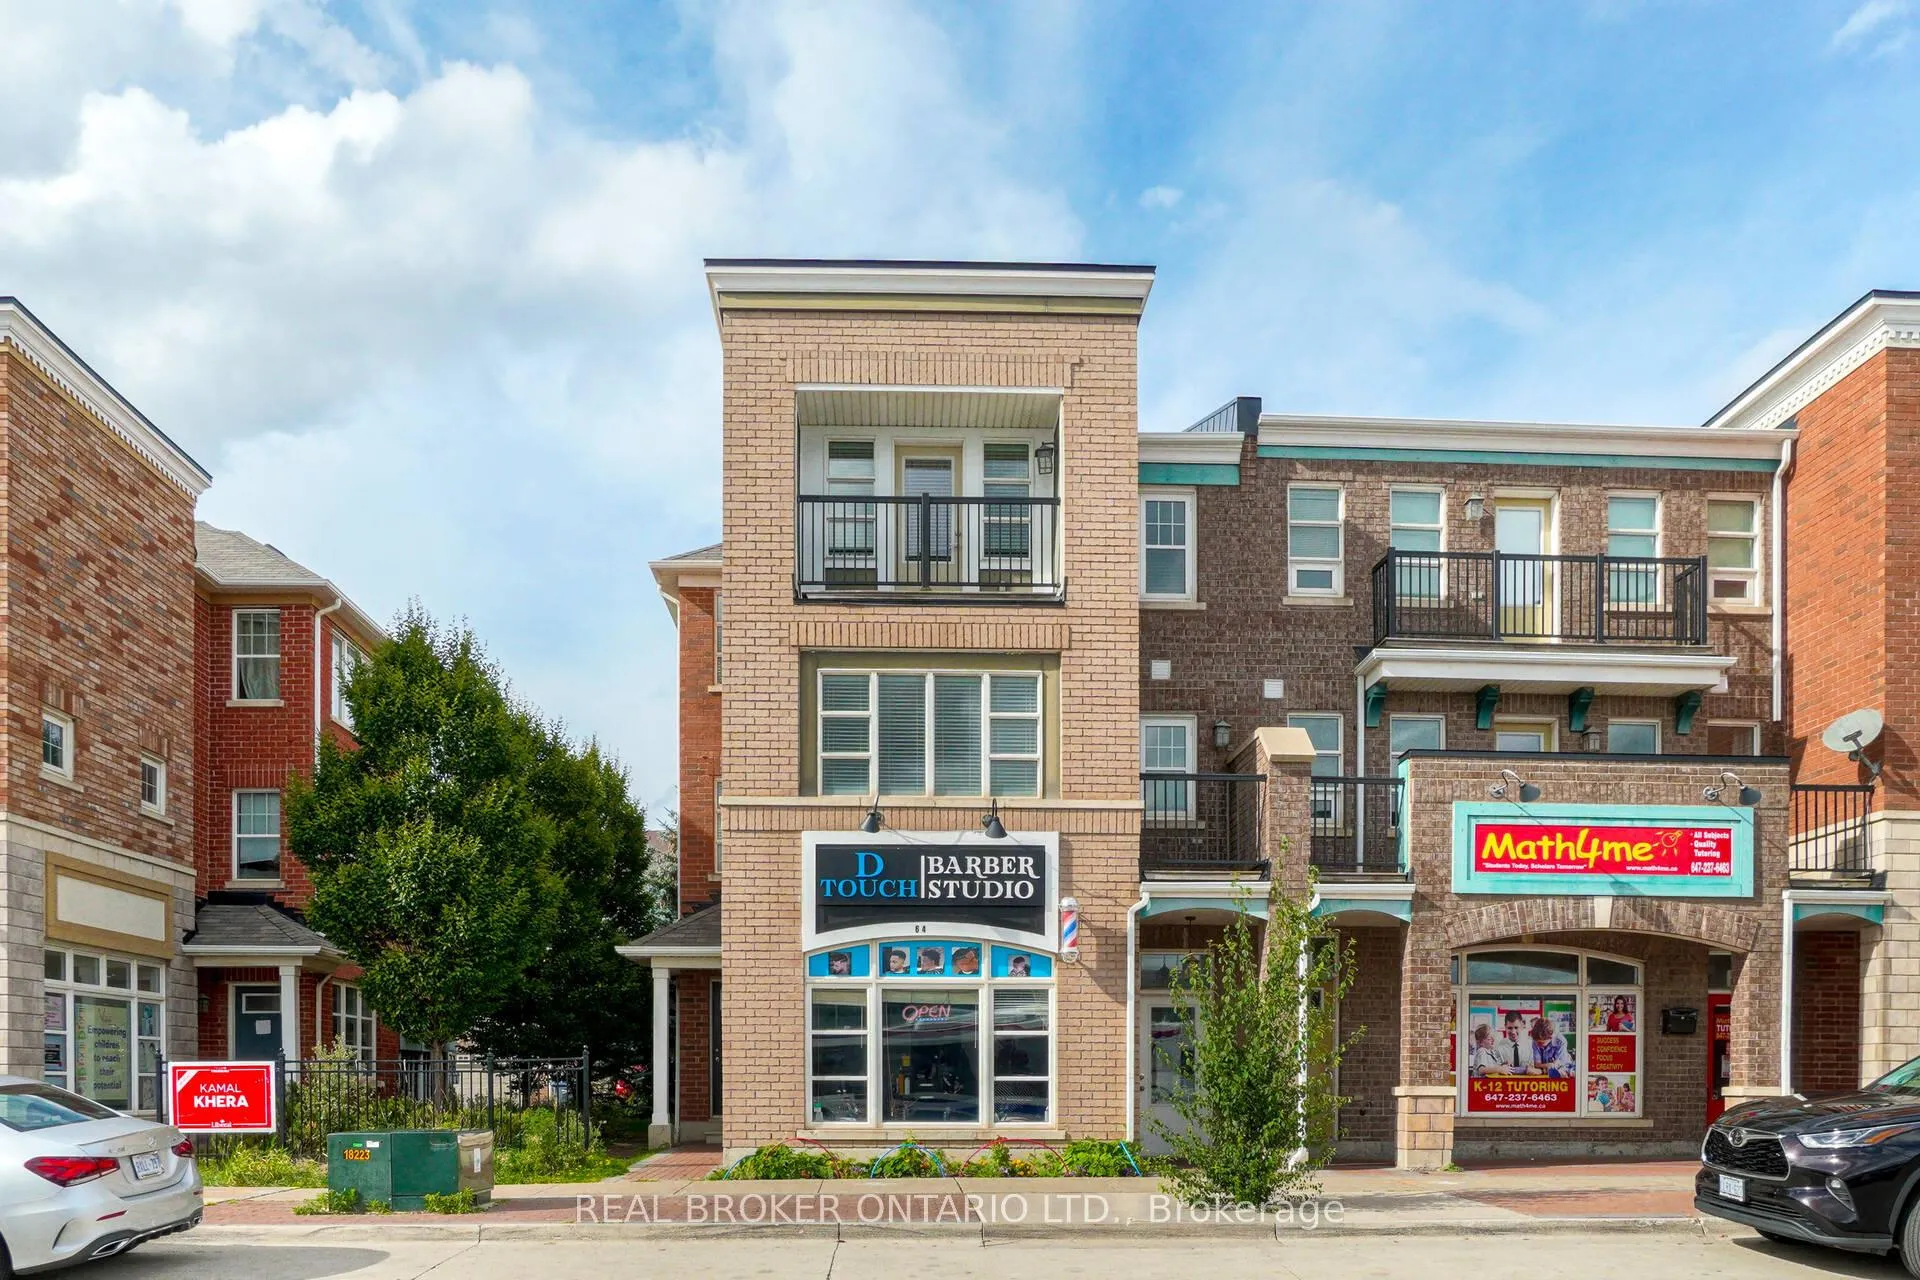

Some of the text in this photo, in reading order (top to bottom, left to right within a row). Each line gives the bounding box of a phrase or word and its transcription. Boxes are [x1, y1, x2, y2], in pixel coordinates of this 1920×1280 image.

[1693, 831, 1730, 840] All Subjects
[1481, 827, 1655, 868] Math4me
[1693, 840, 1717, 849] Quality
[1694, 849, 1721, 858] Tutoring
[855, 852, 884, 878] D
[927, 856, 1040, 879] BARBER
[1690, 862, 1730, 873] 647-237-6463
[820, 879, 918, 898] TOUCH
[928, 880, 1034, 900] STUDIO
[902, 1005, 951, 1022] OPEN
[87, 1025, 127, 1038] Empowering
[94, 1040, 120, 1049] children
[94, 1054, 121, 1062] to reach
[93, 1080, 122, 1090] potential
[199, 1083, 242, 1093] KAMAL
[1473, 1081, 1569, 1092] K-12 TUTORING
[193, 1095, 249, 1108] KHERA
[1484, 1093, 1557, 1101] 647-237-6463
[343, 1149, 370, 1160] 18223
